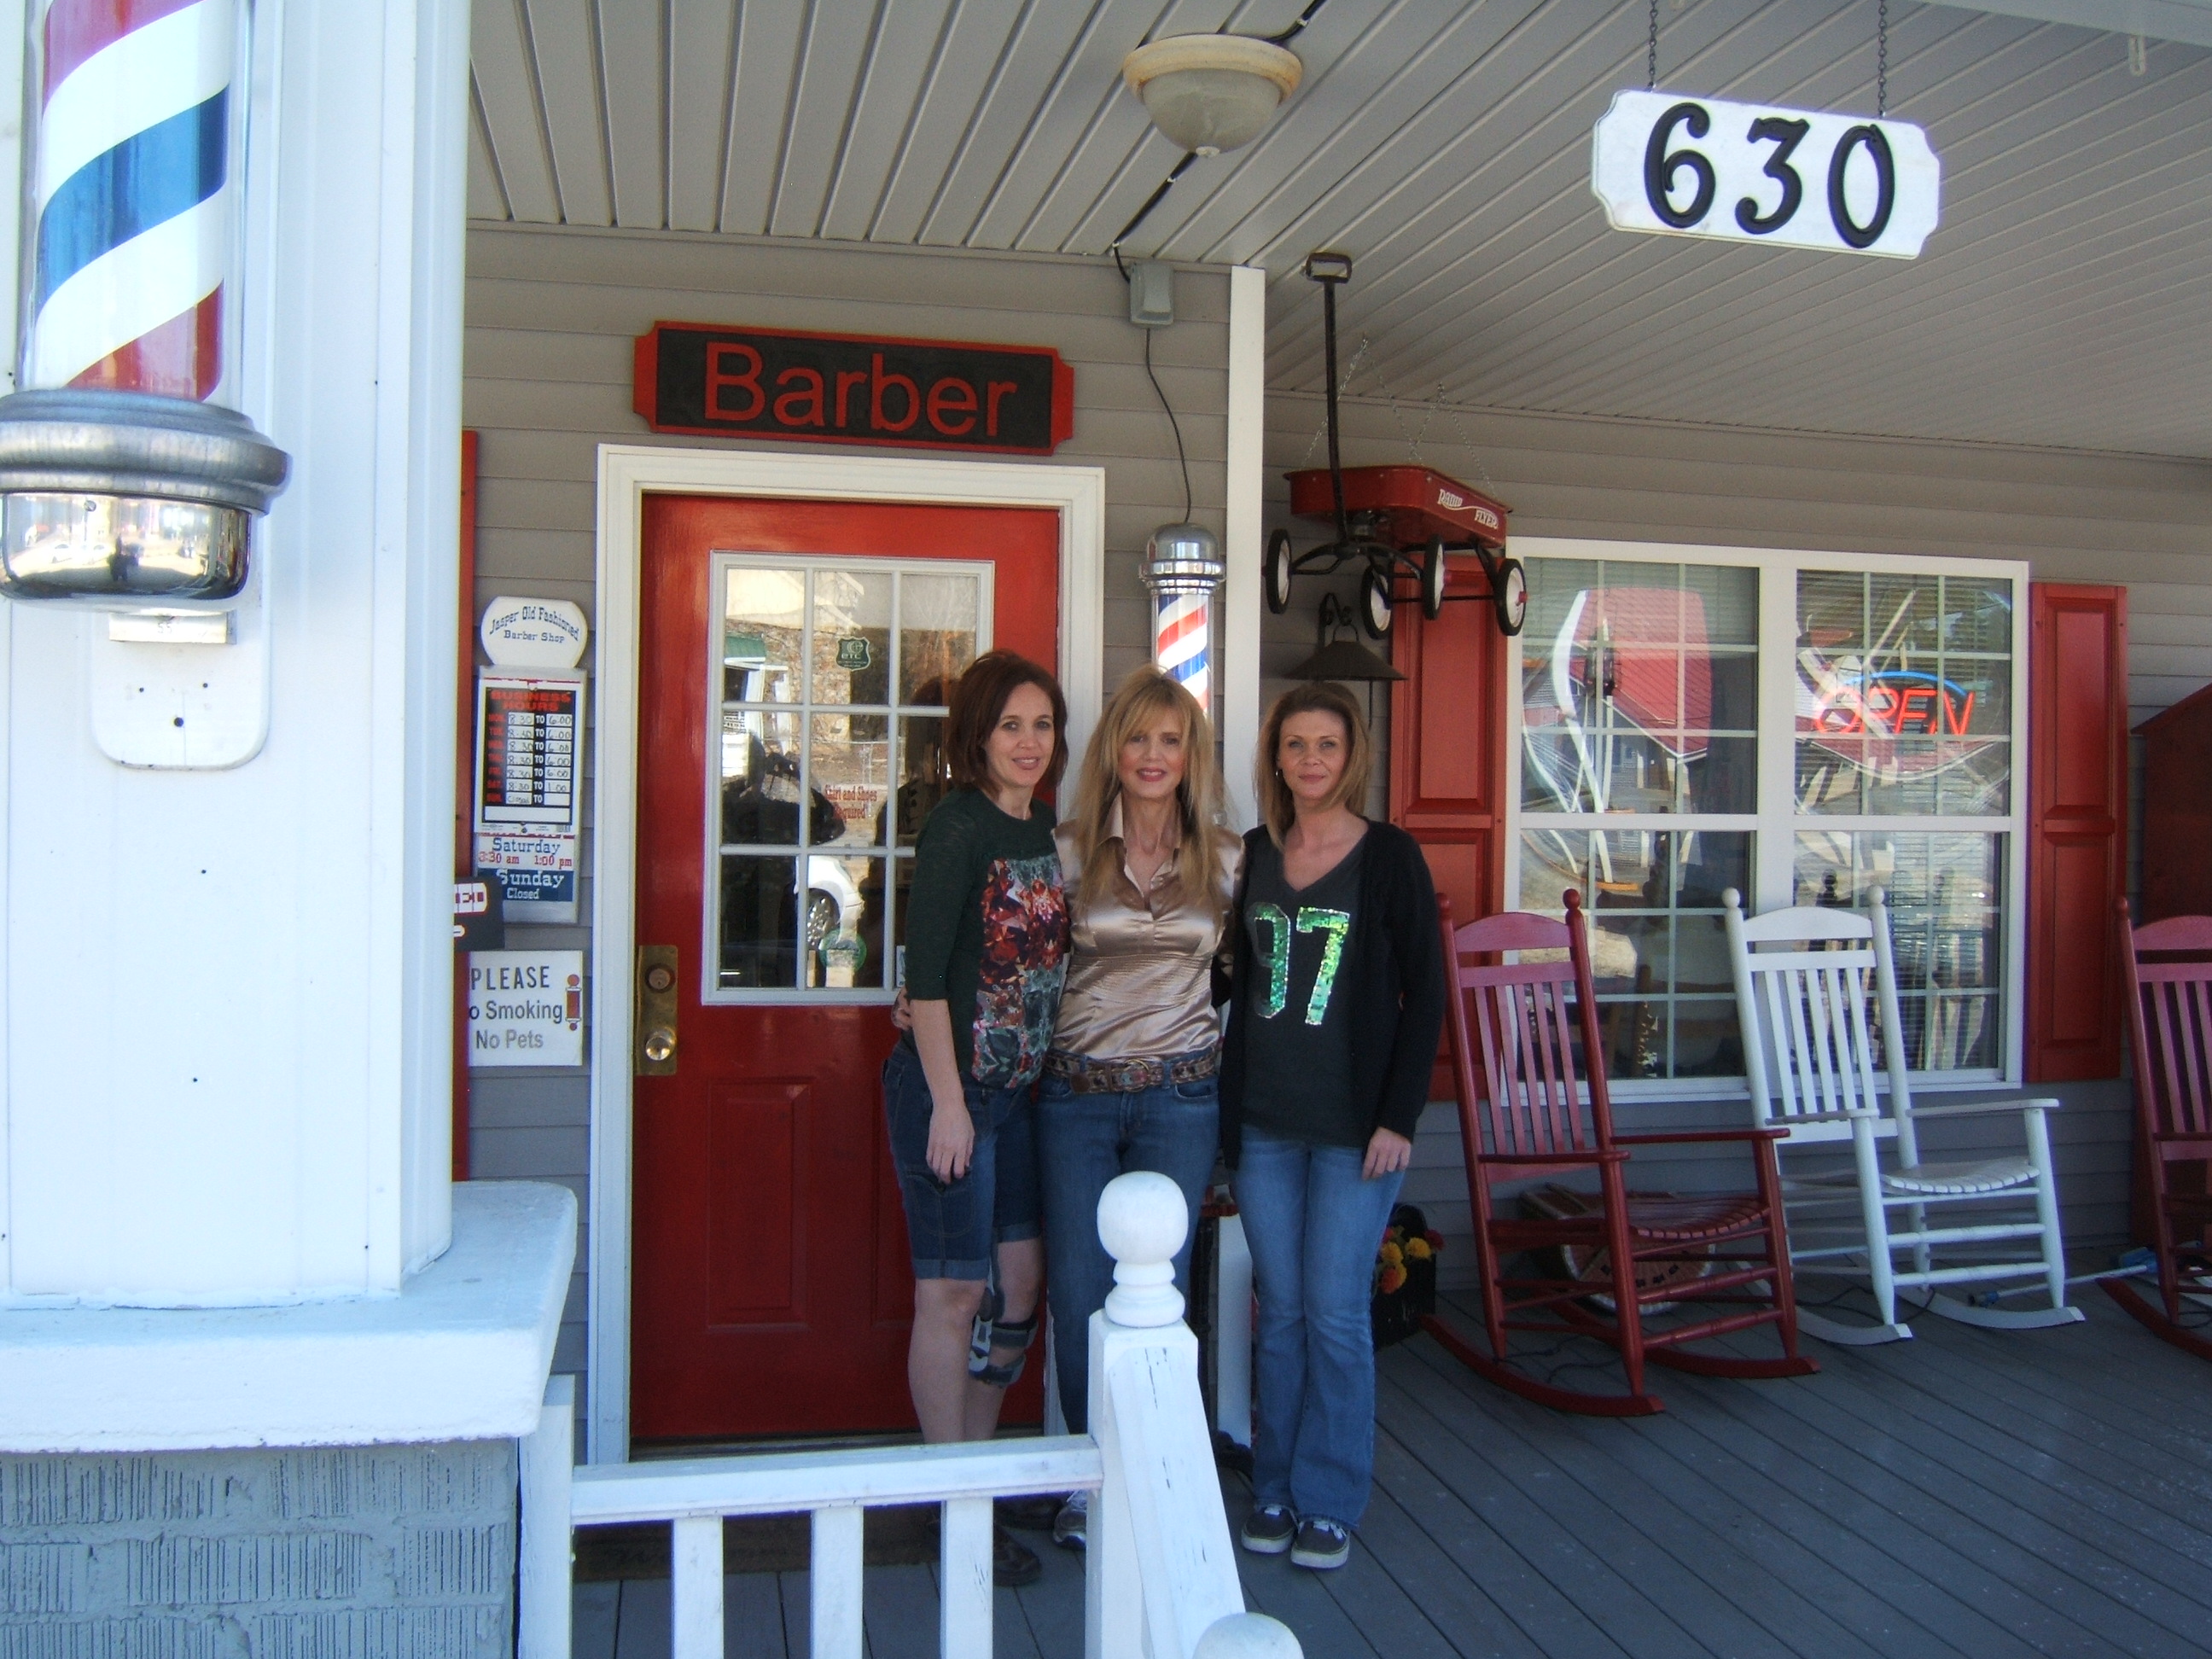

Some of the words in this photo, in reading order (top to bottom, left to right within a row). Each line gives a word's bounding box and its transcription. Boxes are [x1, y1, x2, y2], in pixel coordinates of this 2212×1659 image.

[1644, 102, 1895, 249] 630
[704, 341, 1017, 436] Barber
[489, 611, 520, 635] Jasper
[522, 606, 537, 620] Old
[538, 607, 579, 641] Fashioned
[504, 630, 538, 641] Barber
[541, 632, 565, 643] Shop
[1813, 686, 1976, 736] OPEN
[535, 714, 545, 725] TO
[534, 728, 545, 737] TO
[534, 741, 544, 751] TO
[534, 754, 544, 764] TO
[533, 768, 544, 777] TO
[533, 781, 544, 789] TO
[842, 786, 856, 800] and
[858, 785, 877, 801] Shoes
[533, 794, 544, 803] TO
[492, 837, 561, 855] Saturday
[534, 855, 555, 865] 1:00
[559, 859, 573, 870] pm
[496, 869, 564, 888] Sunday
[507, 888, 540, 899] Closed
[1245, 902, 1350, 1026] 97
[470, 965, 550, 991] PLEASE
[469, 1005, 480, 1020] o
[486, 999, 562, 1024] Smoking
[476, 1029, 500, 1050] No
[506, 1029, 544, 1049] Pets
